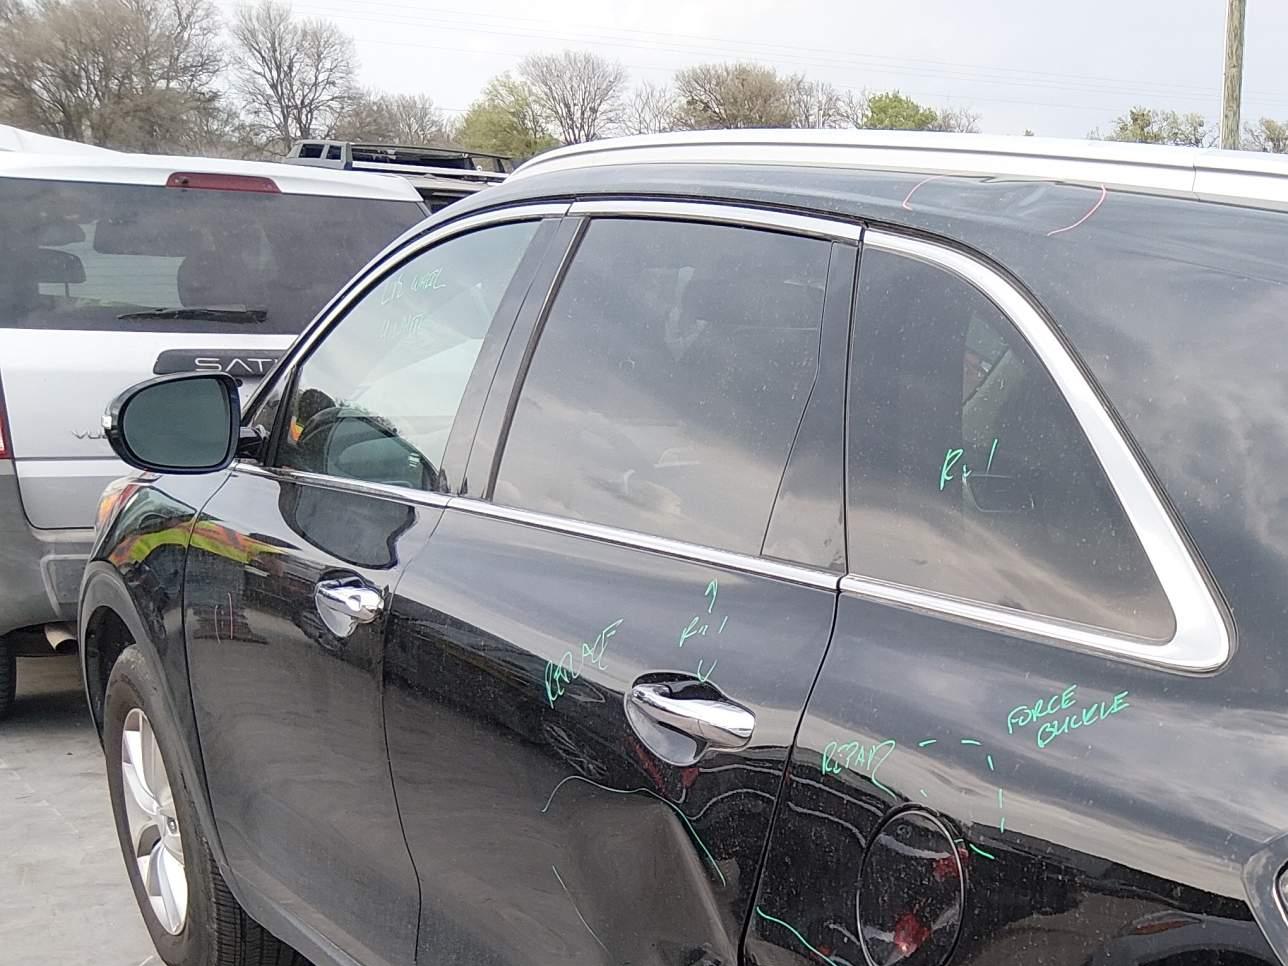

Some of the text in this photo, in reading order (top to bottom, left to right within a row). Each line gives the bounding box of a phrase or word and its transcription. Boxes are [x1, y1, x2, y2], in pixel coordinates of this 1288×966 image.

[195, 357, 278, 373] SAT
[71, 428, 108, 439] VU
[1007, 684, 1077, 734] FORCE
[1036, 691, 1131, 748] BUCKLE
